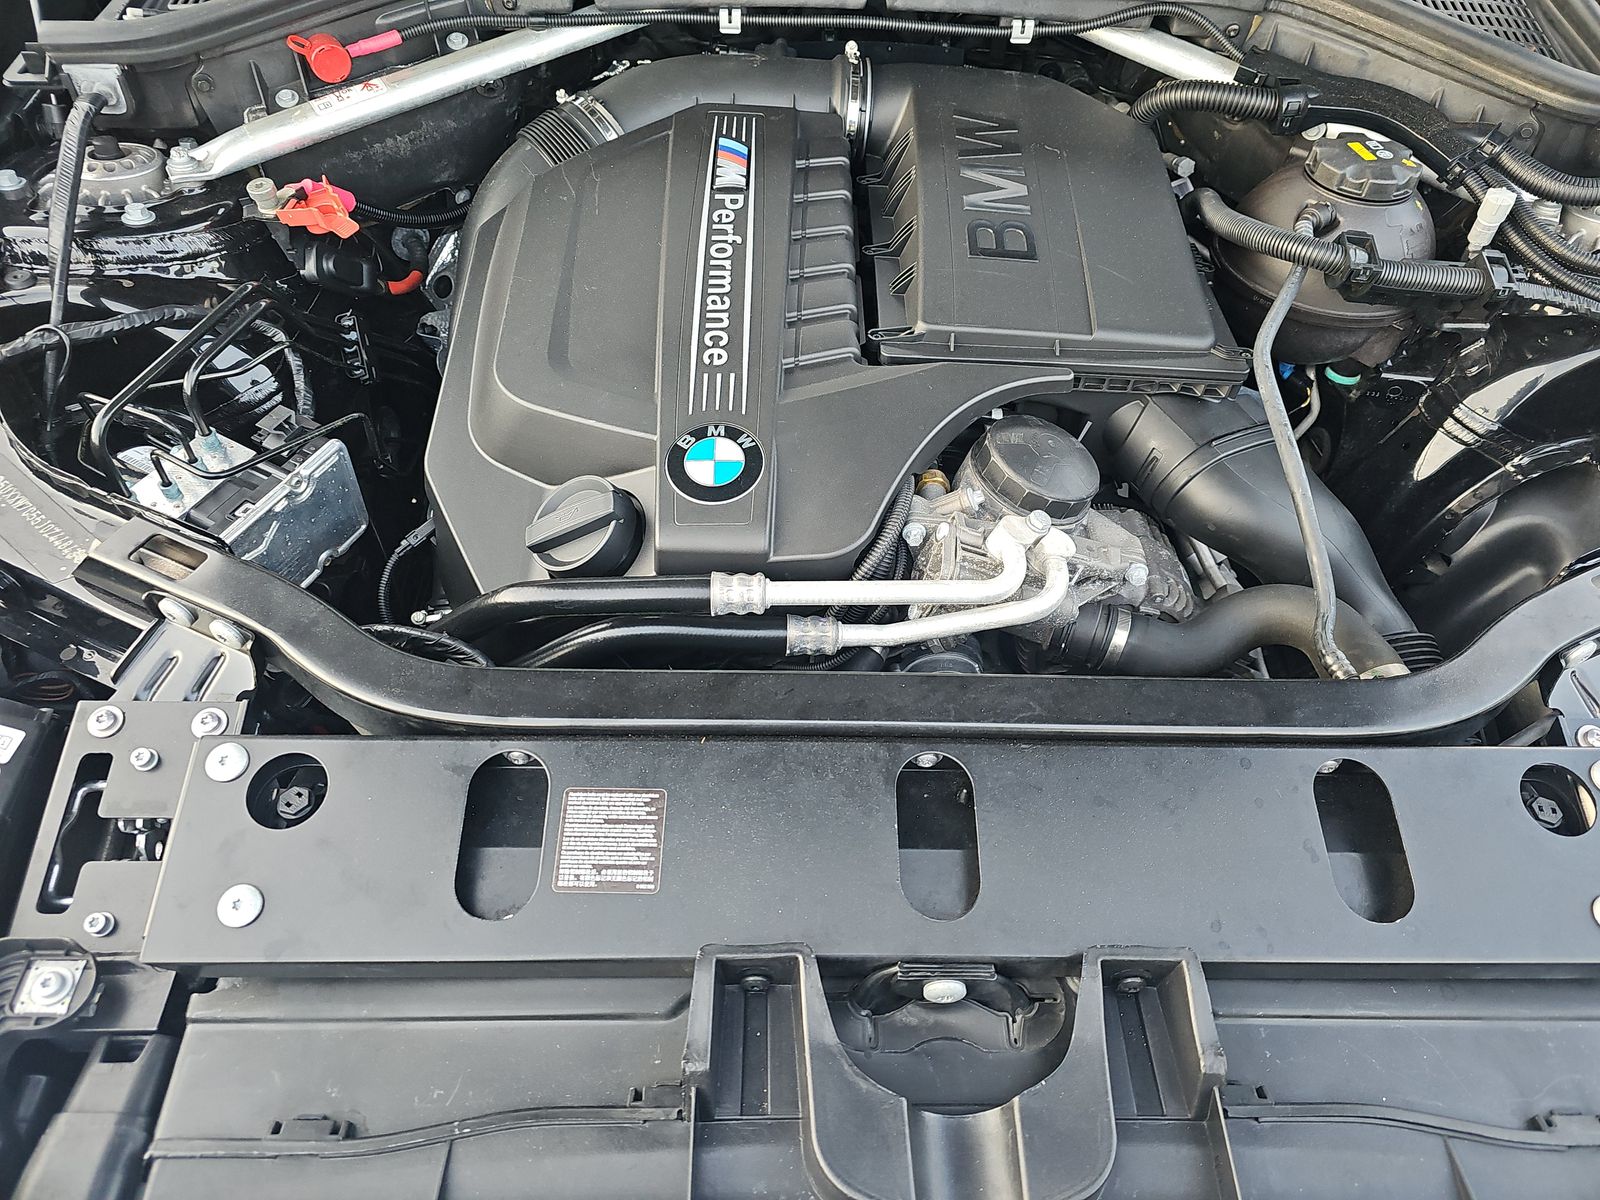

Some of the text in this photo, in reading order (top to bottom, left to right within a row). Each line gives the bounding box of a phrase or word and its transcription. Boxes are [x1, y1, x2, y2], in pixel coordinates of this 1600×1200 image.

[952, 112, 1039, 262] BMW
[702, 193, 745, 366] Performance
[676, 425, 757, 450] BMW
